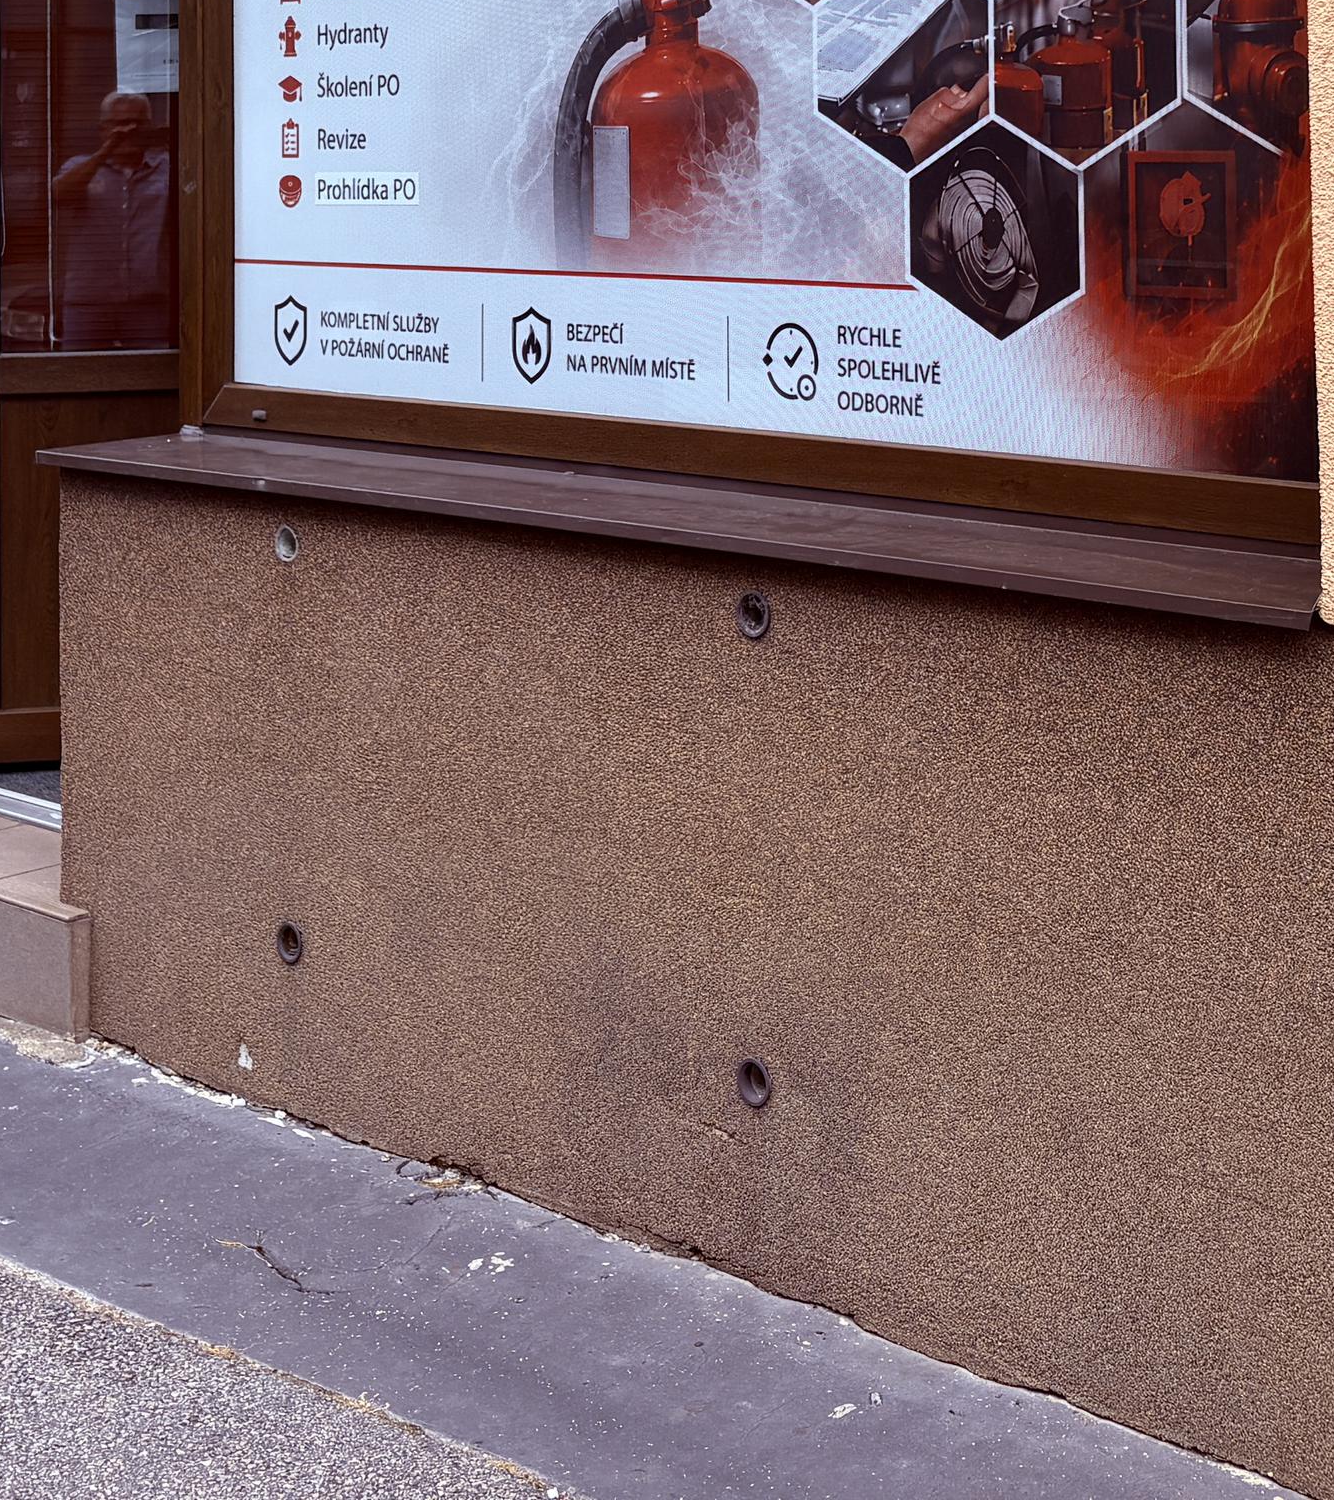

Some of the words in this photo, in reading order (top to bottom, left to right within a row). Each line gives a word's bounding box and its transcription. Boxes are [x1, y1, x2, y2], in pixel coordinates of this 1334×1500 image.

[317, 21, 389, 52] Hydranty
[316, 71, 374, 98] Školení
[377, 73, 401, 97] PO
[317, 127, 367, 151] Revize
[317, 177, 389, 201] Prohlídka
[393, 177, 416, 201] PO
[320, 310, 390, 332] KOMPLETNÍ
[392, 312, 440, 335] SLUŽBY
[566, 321, 624, 345] BEZPEČÍ
[837, 325, 902, 348] RYCHLE
[320, 338, 329, 356] V
[330, 337, 386, 360] POŽÁRNÍ
[387, 342, 450, 365] OCHRANĚ
[566, 353, 588, 373] NA
[590, 354, 647, 378] PRVNÍM
[651, 356, 696, 381] MÍSTĚ
[837, 357, 942, 385] SPOLEHLIVĚ
[837, 390, 924, 417] ODBORNĚ
